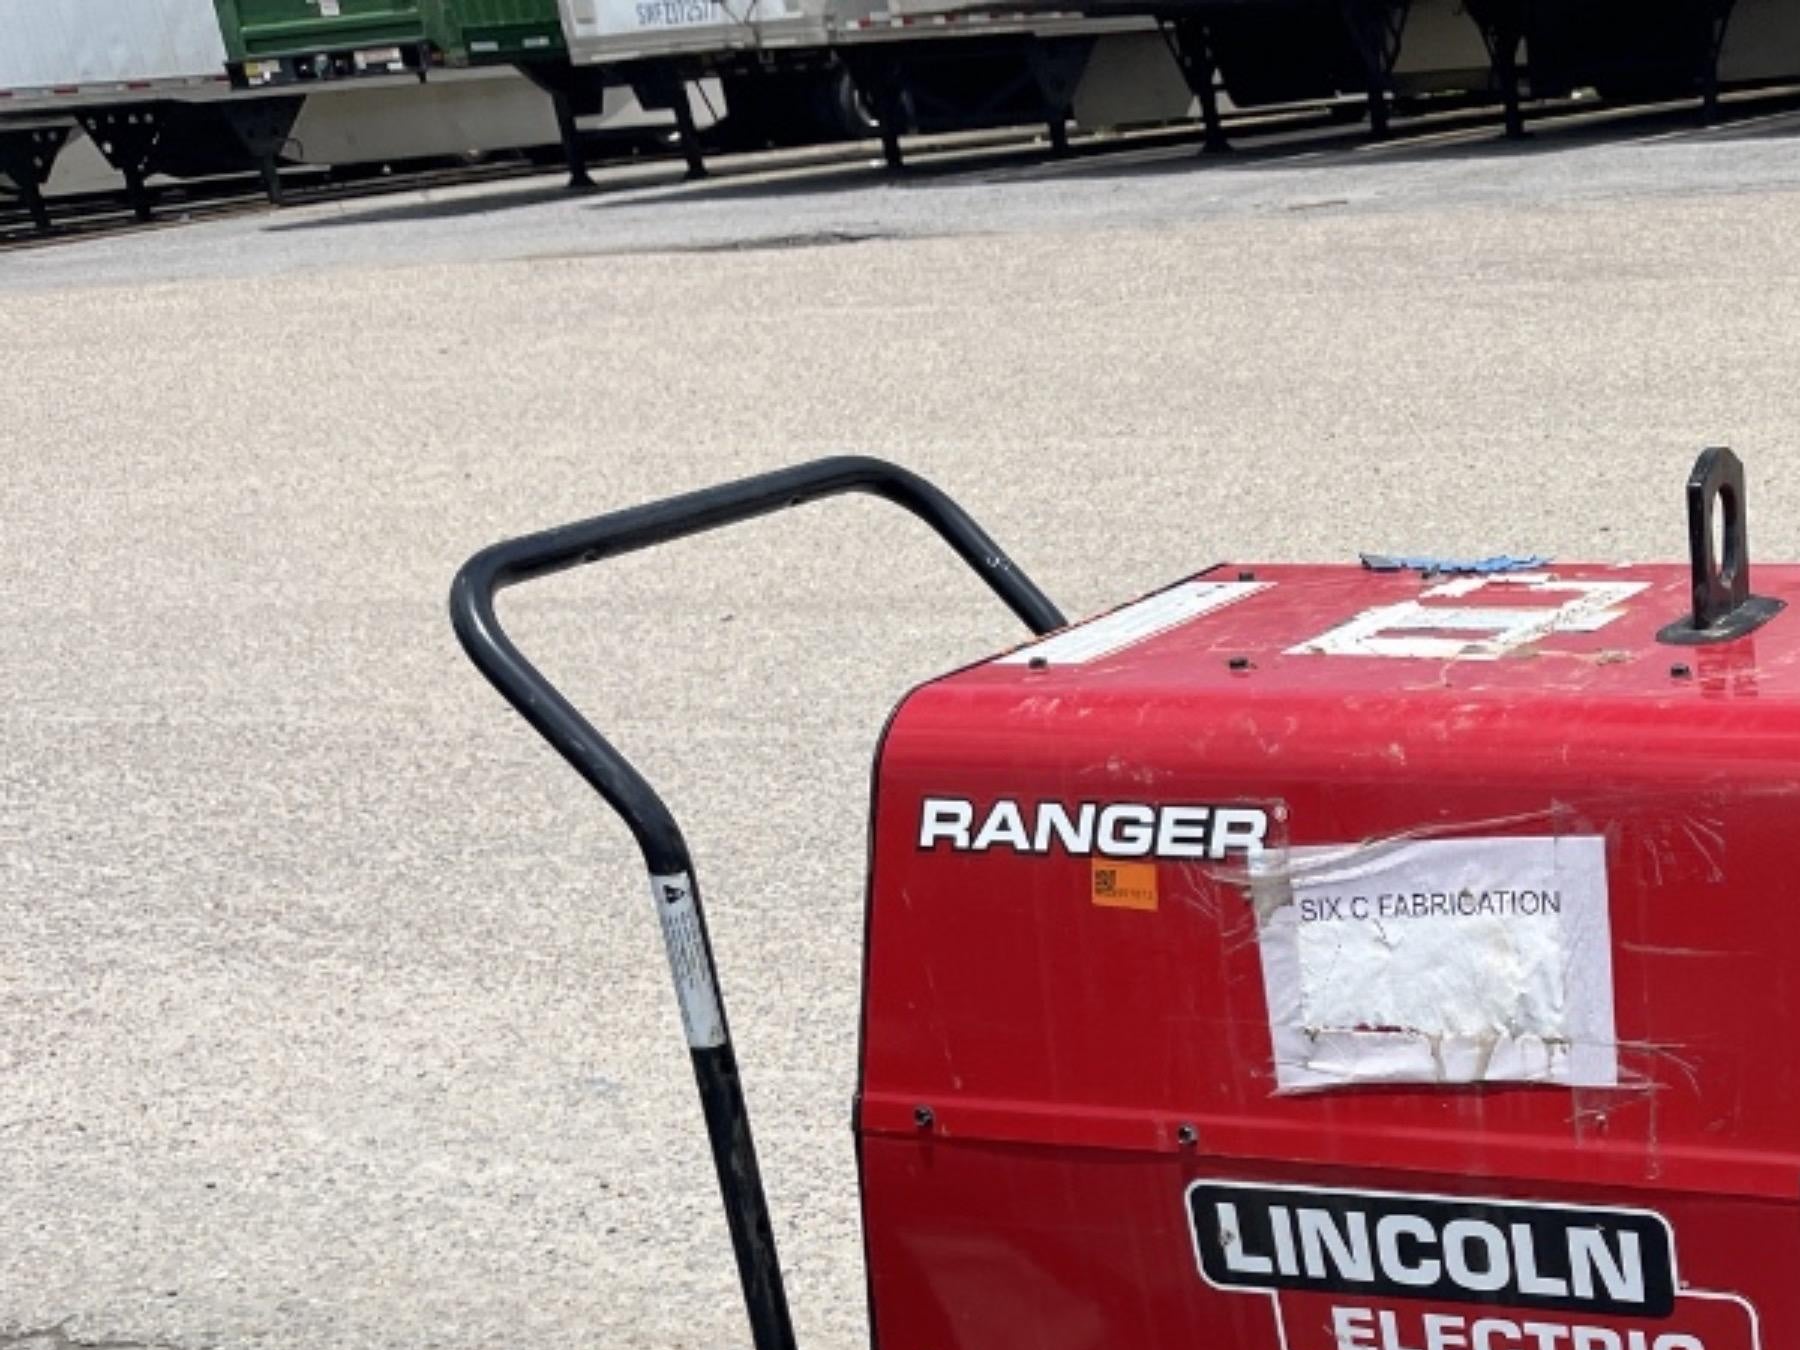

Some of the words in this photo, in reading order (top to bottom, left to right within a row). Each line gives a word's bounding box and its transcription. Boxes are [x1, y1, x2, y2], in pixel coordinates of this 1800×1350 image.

[918, 799, 1268, 858] RANGER
[1300, 896, 1342, 922] SIX
[1351, 895, 1369, 920] C
[1378, 889, 1561, 918] FABRICATION
[1215, 1201, 1646, 1304] LINCOLN
